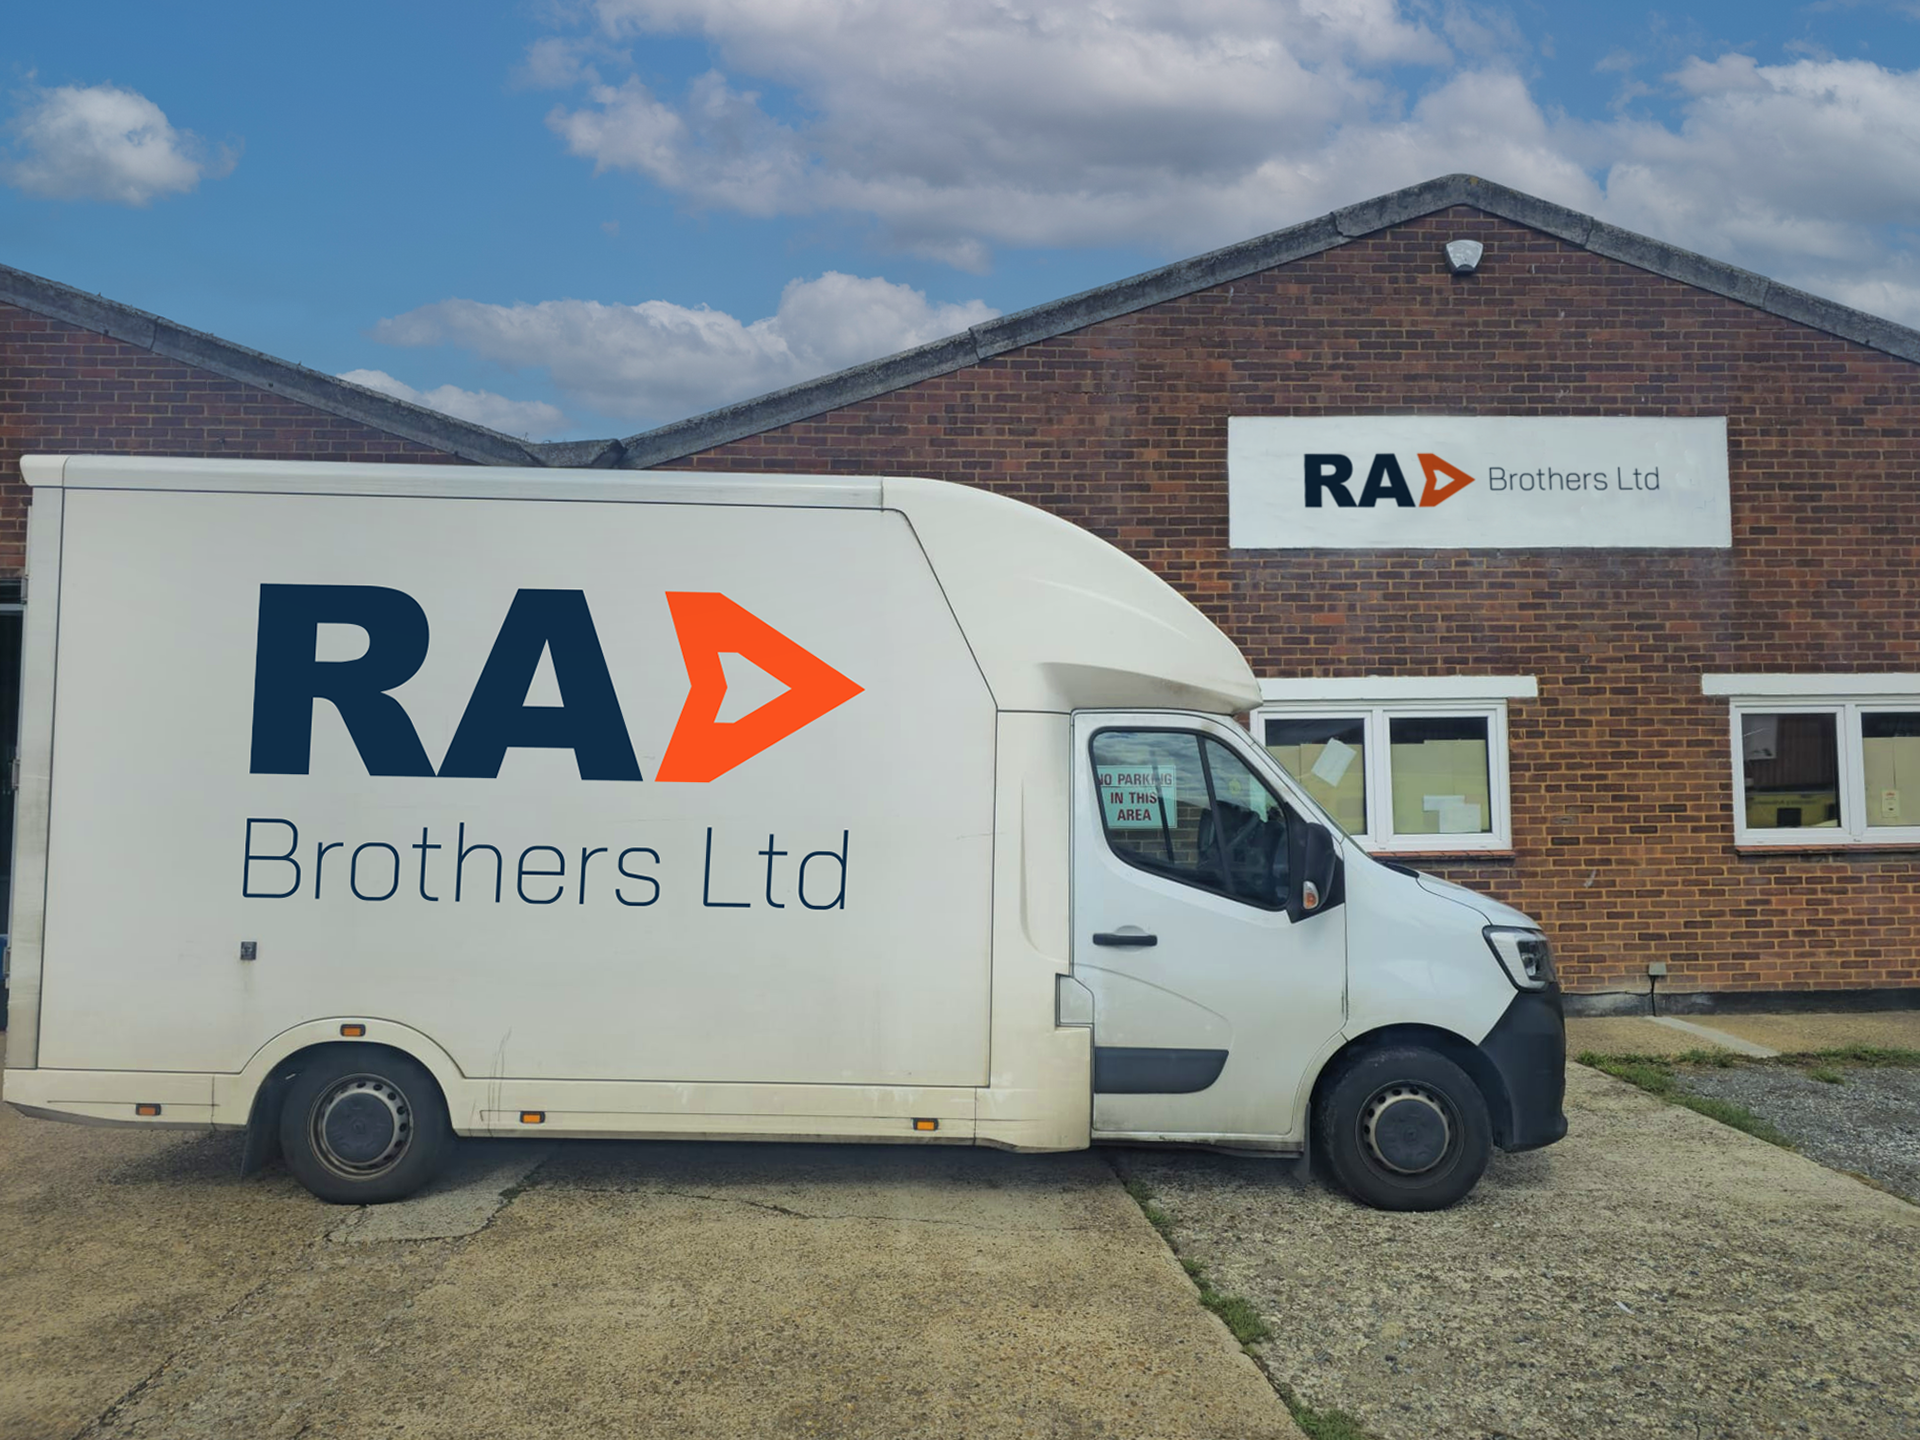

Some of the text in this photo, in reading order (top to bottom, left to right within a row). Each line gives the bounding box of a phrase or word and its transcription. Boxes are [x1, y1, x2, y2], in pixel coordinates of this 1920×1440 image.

[1489, 467, 1608, 491] Brothers
[1617, 467, 1660, 491] Ltd
[1110, 792, 1157, 804] IN THIS
[1117, 809, 1151, 821] AREA
[242, 818, 849, 910] Brothers Ltd
